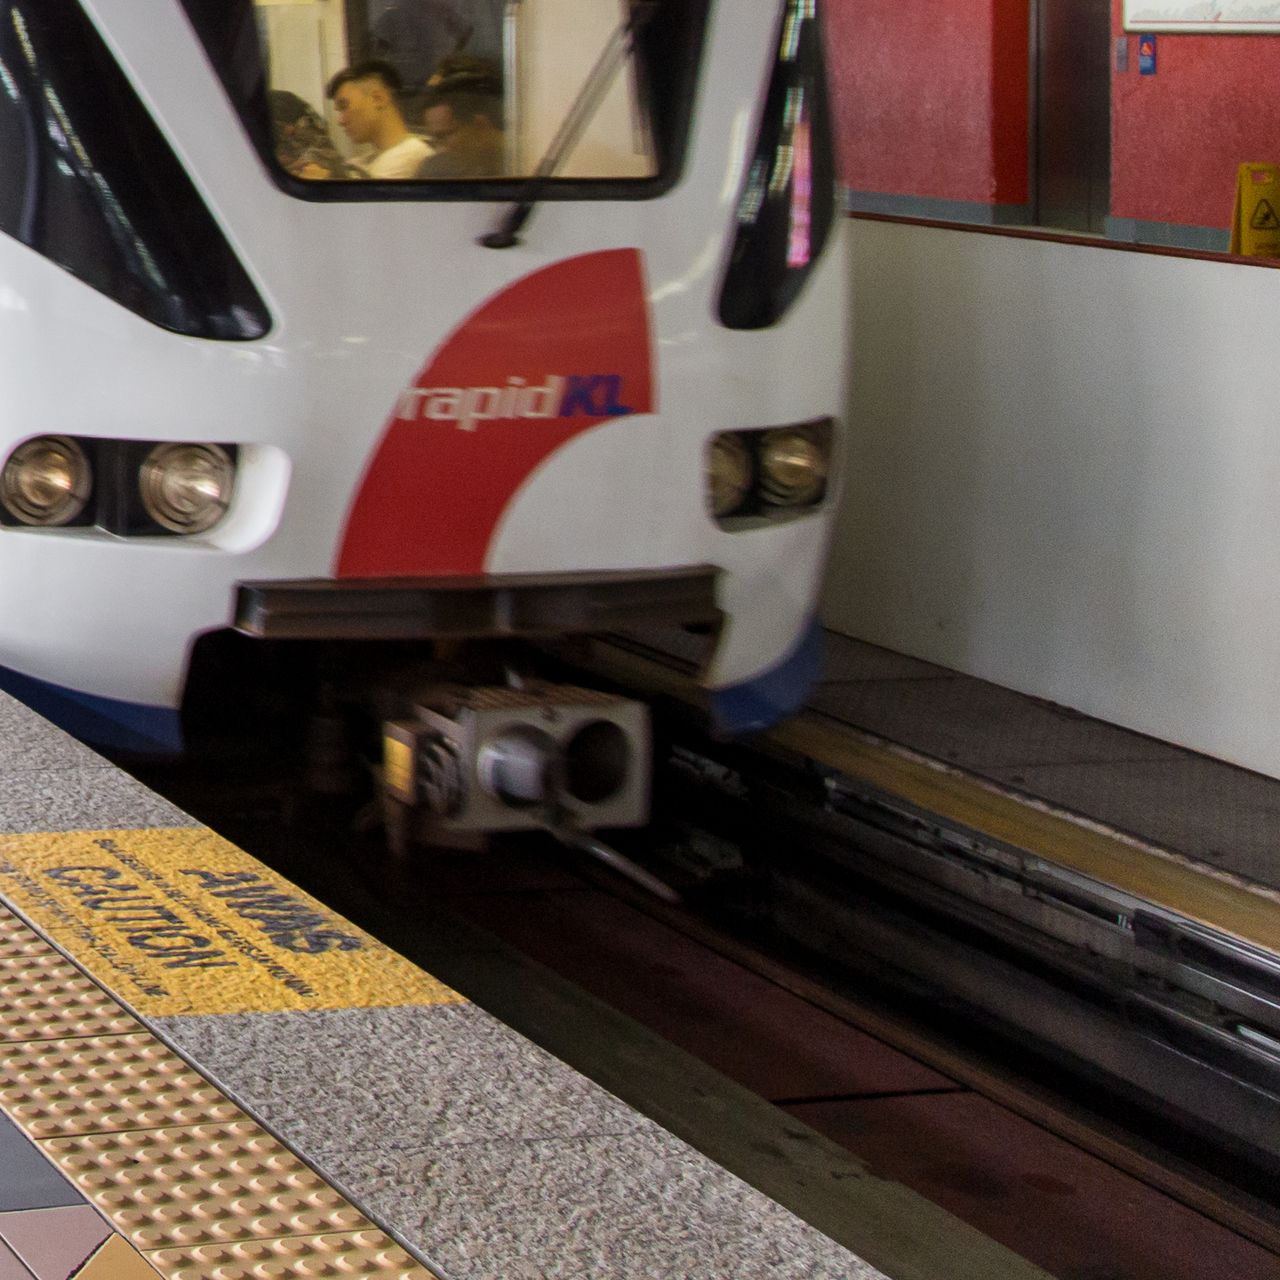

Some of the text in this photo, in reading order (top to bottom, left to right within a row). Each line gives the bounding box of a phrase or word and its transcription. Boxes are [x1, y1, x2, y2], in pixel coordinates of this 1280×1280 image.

[395, 375, 635, 432] rapidKL
[42, 865, 239, 970] CAUTION
[180, 867, 362, 954] AWAS
